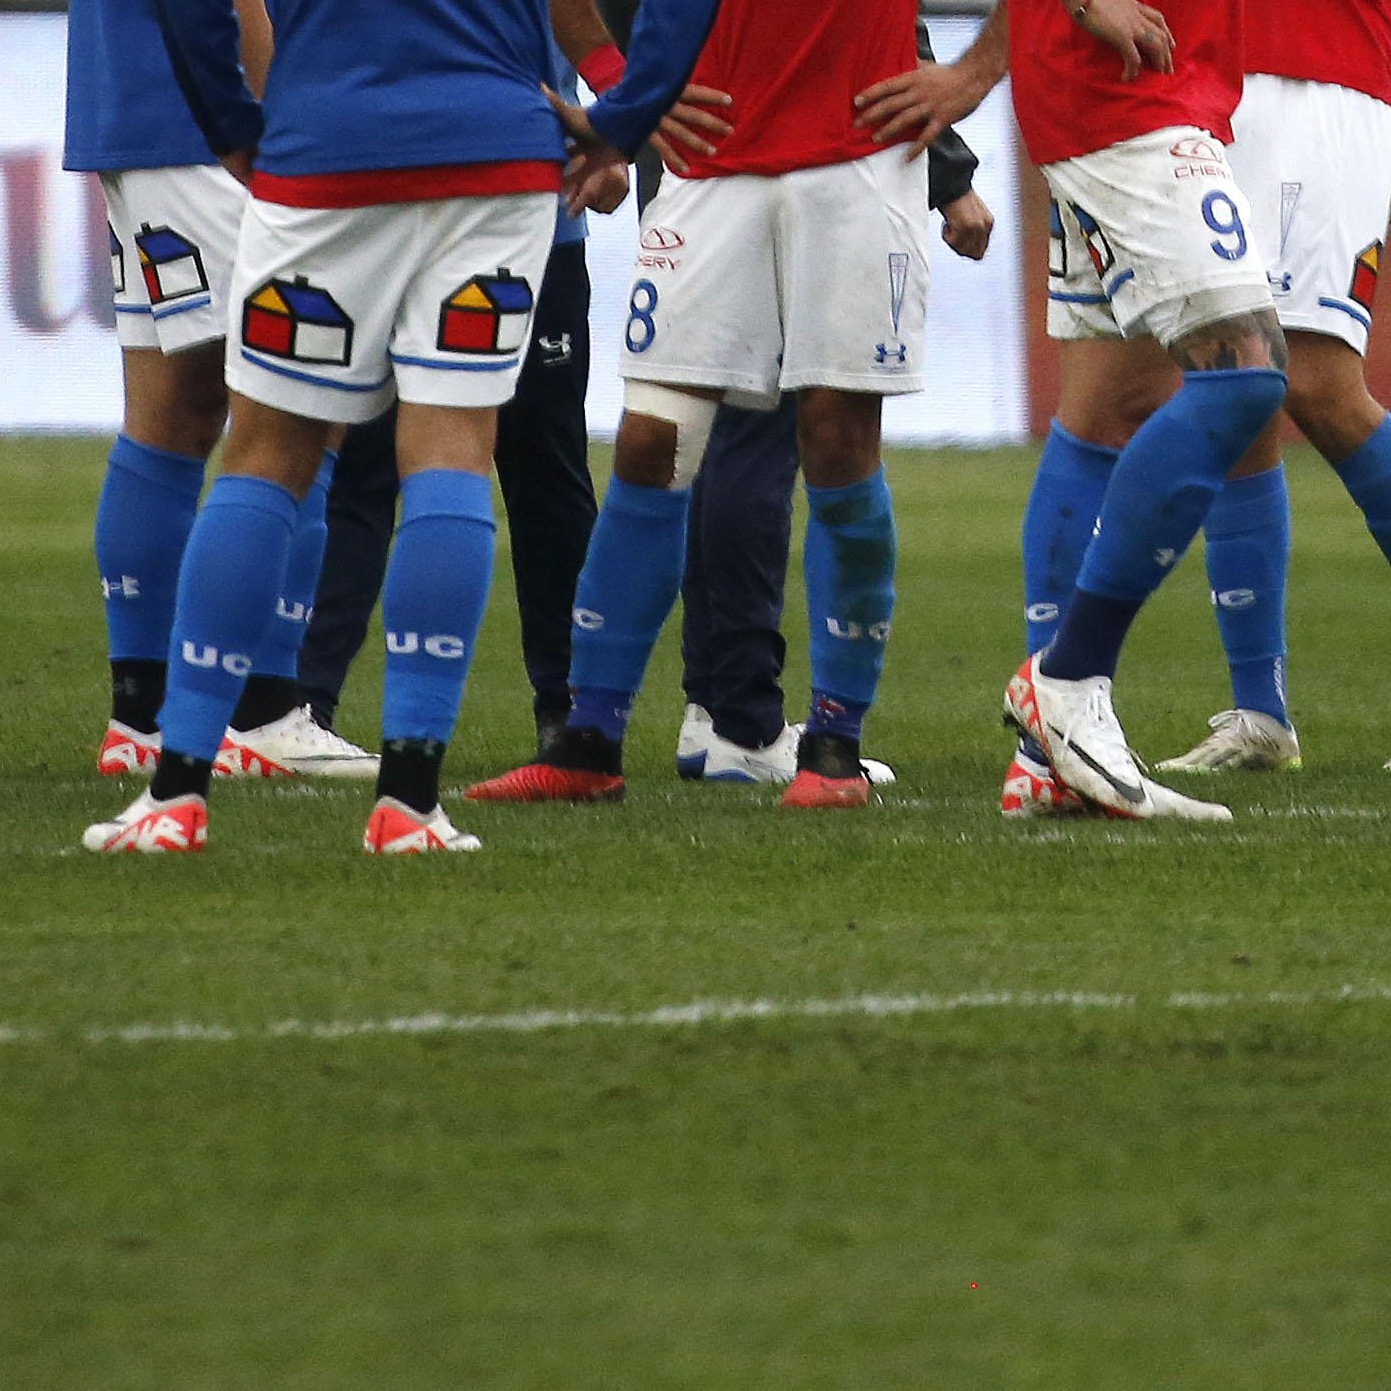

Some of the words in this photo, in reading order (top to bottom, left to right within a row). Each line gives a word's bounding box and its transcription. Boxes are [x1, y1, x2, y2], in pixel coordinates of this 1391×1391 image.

[1201, 189, 1247, 261] 9
[626, 278, 658, 353] 8
[182, 640, 253, 677] UC
[386, 630, 465, 659] UC
